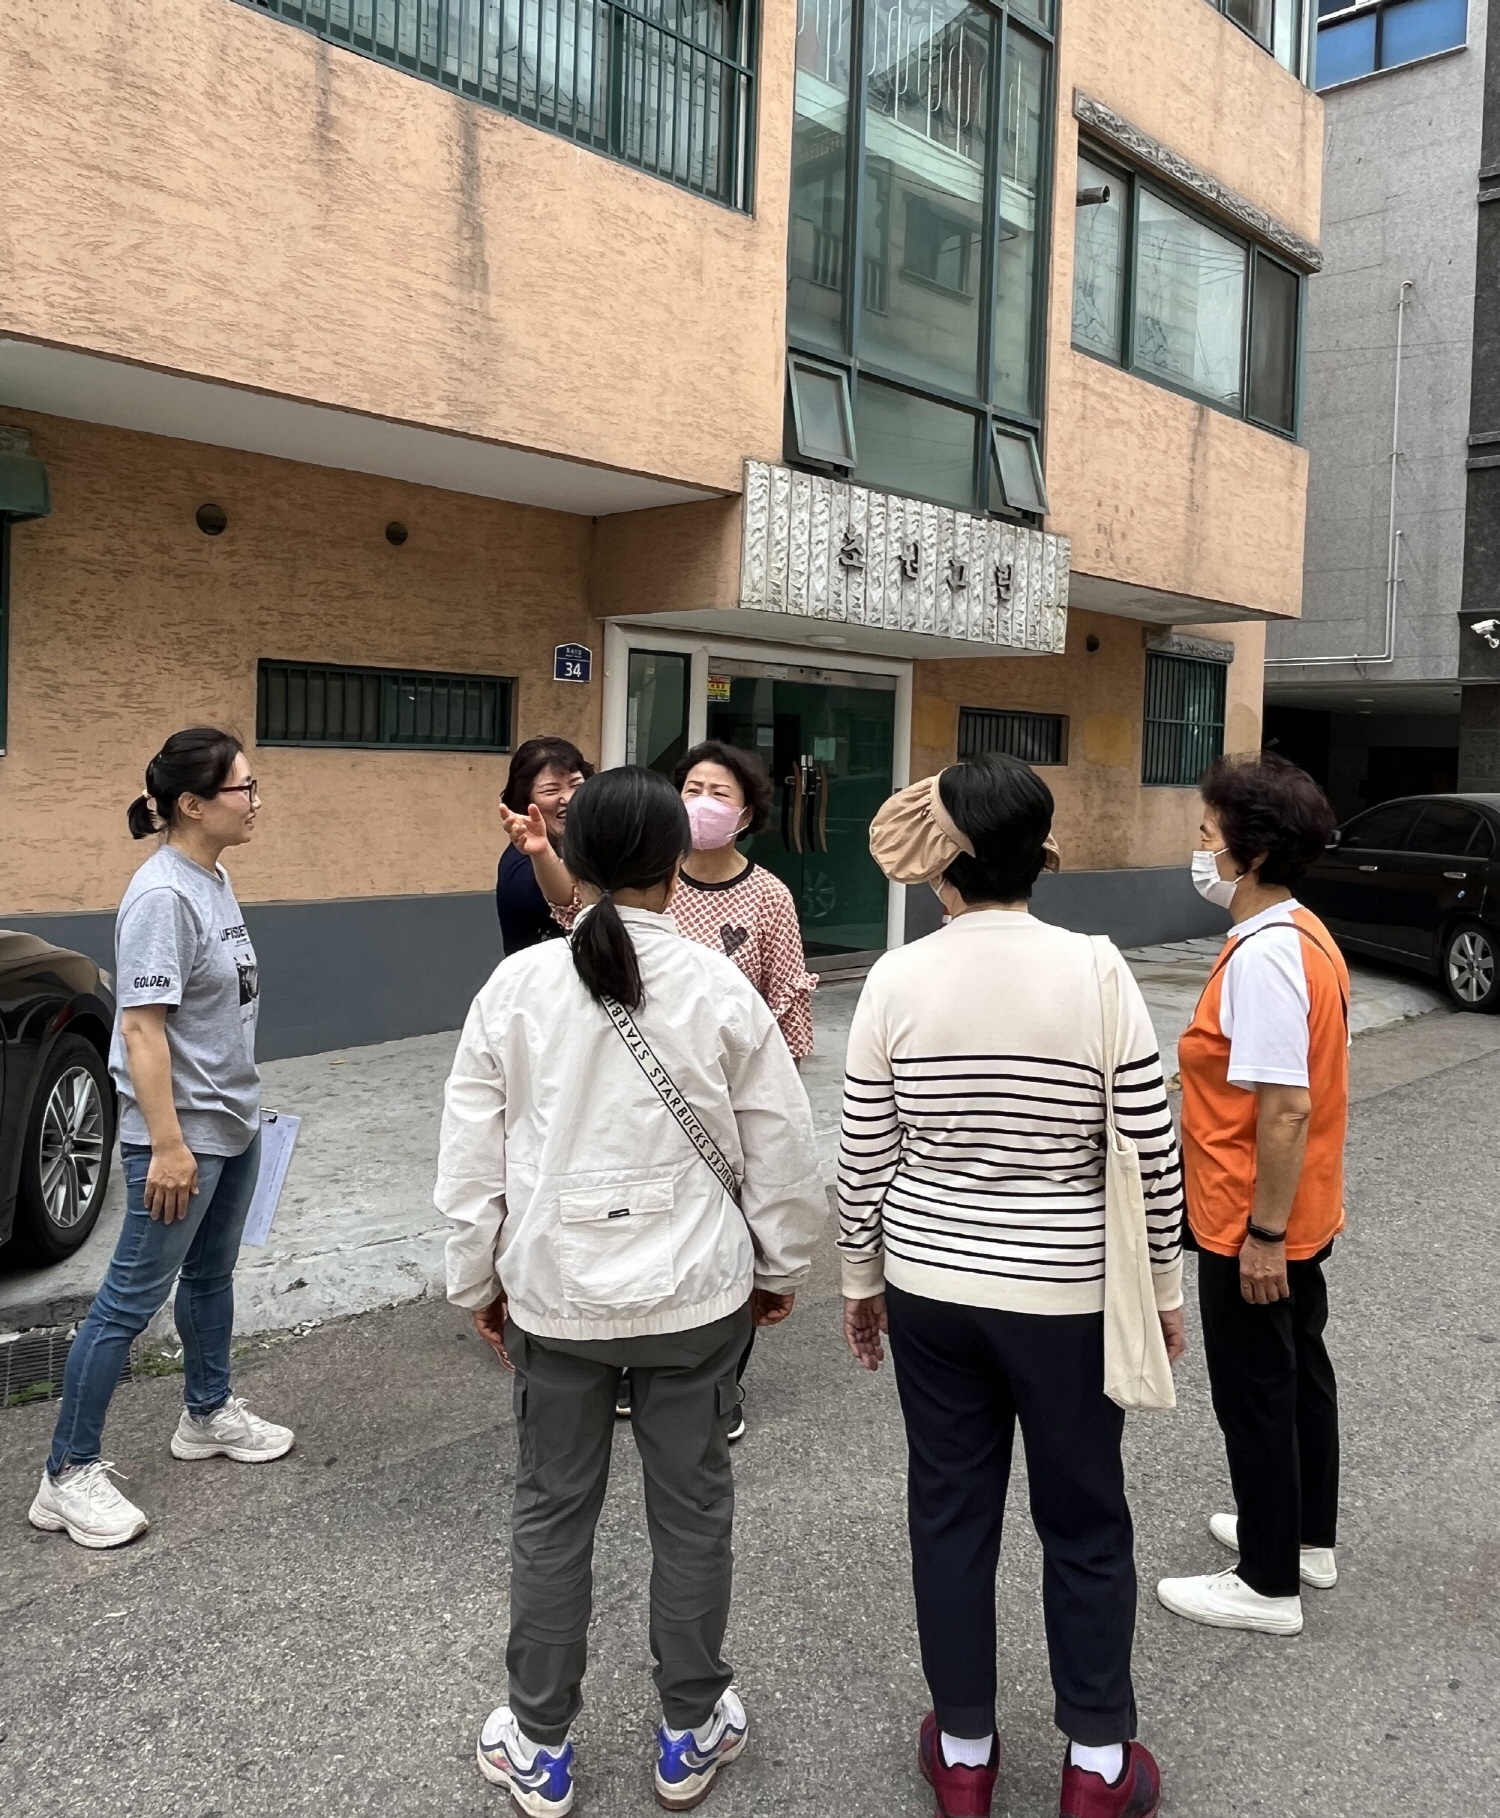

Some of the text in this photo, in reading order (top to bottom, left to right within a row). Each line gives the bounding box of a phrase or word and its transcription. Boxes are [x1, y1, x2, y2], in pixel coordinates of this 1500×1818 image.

[564, 661, 582, 678] 34
[133, 975, 171, 989] GOLDEN
[650, 1067, 710, 1149] STARBUCKS
